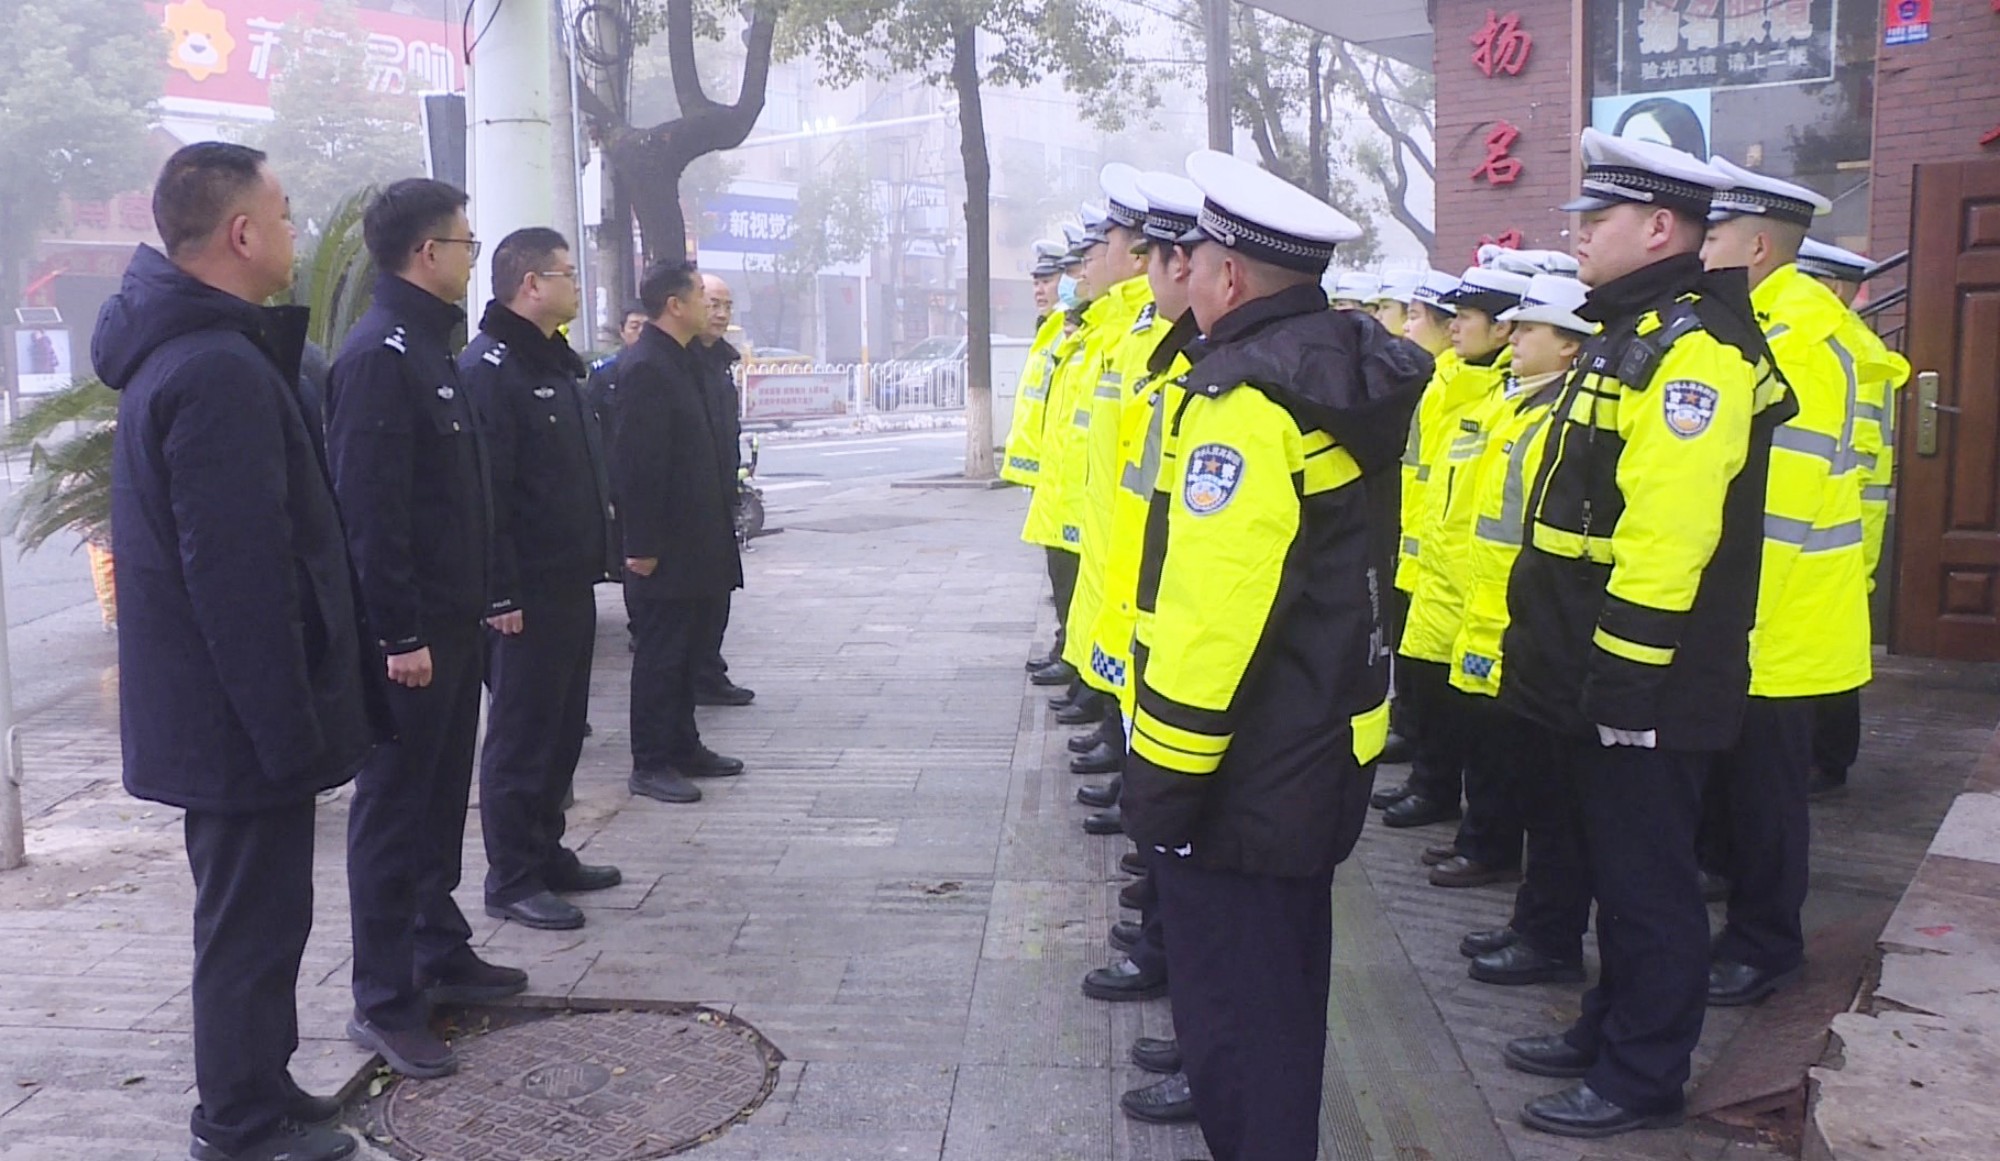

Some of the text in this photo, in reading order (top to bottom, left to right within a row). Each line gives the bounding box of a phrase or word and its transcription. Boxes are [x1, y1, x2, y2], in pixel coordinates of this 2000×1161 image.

[1641, 45, 1809, 80] 验光配镜 请上二楼
